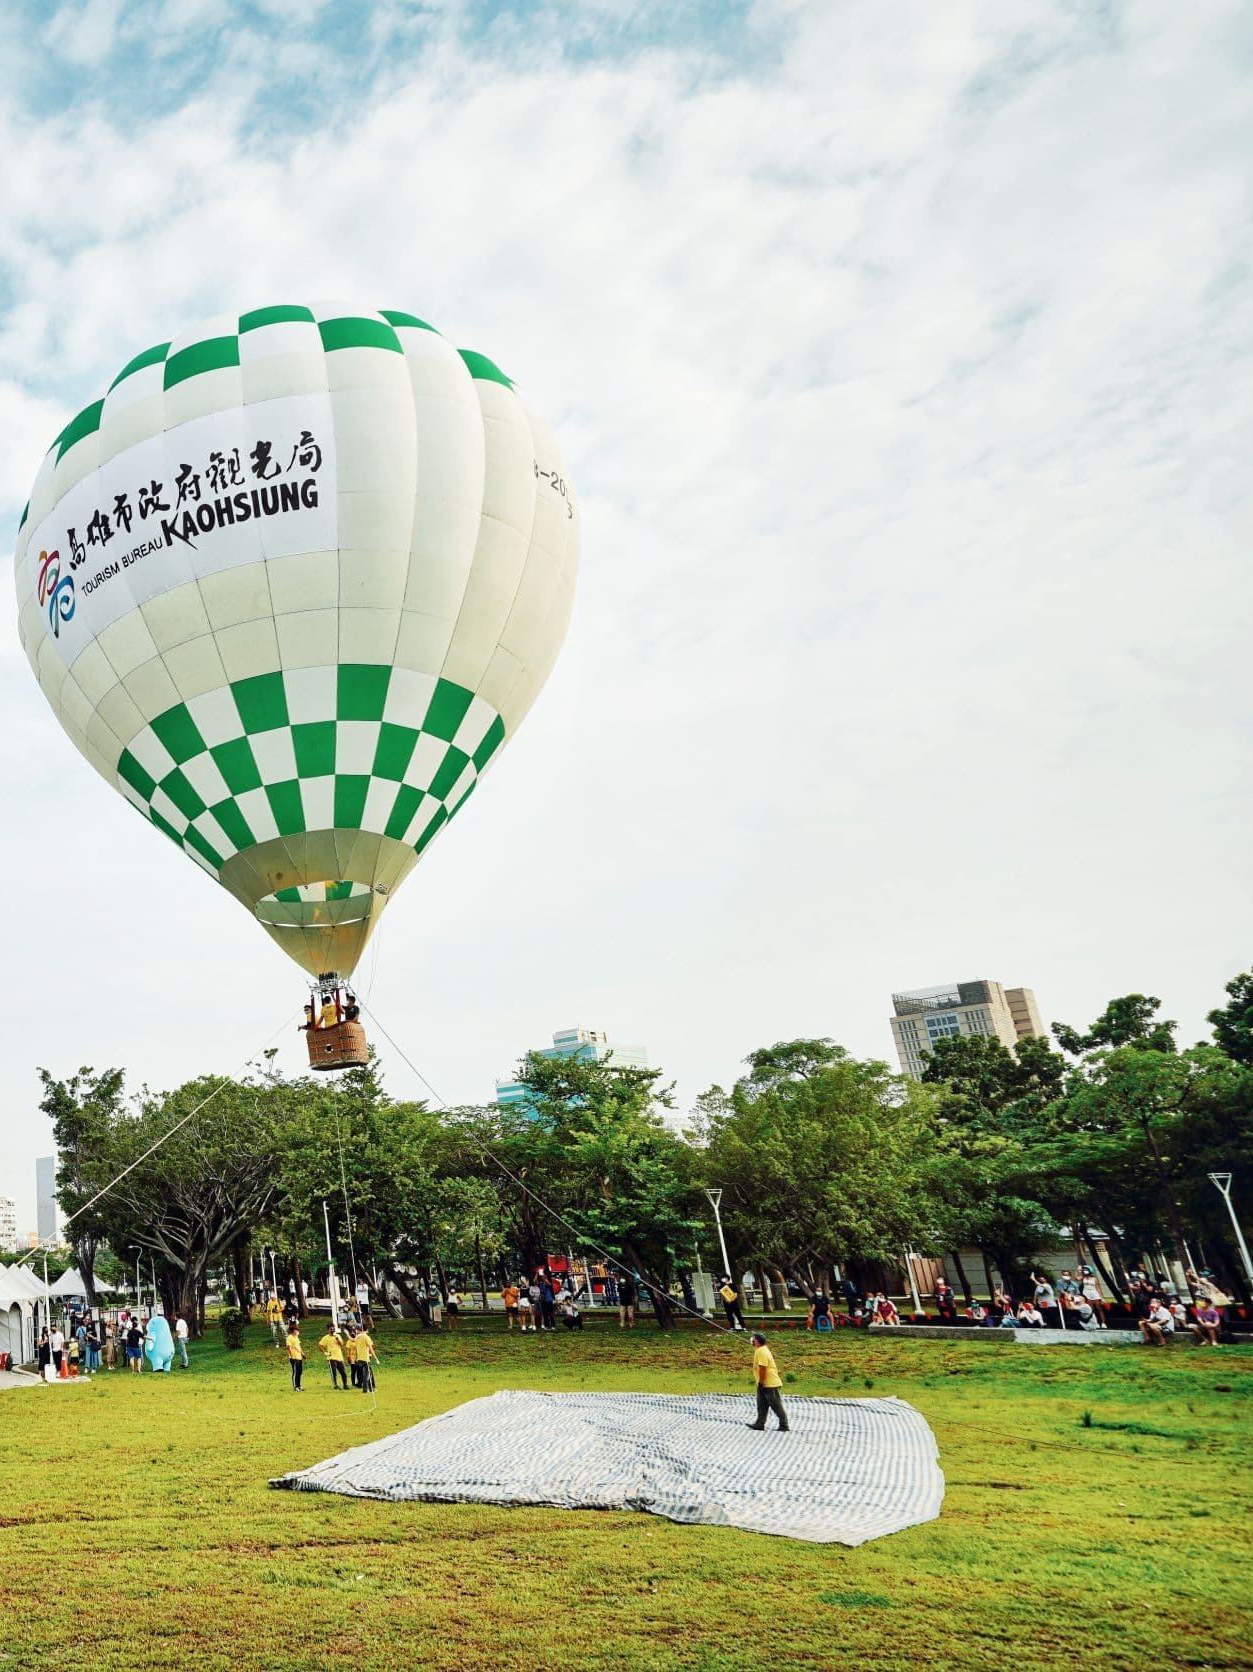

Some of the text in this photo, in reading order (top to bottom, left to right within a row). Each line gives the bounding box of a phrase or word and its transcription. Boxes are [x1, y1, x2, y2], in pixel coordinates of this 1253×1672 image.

[67, 431, 323, 570] 高雄市政府觀光局
[81, 478, 319, 597] TOURISM BUREAU KAOHSIUNG
